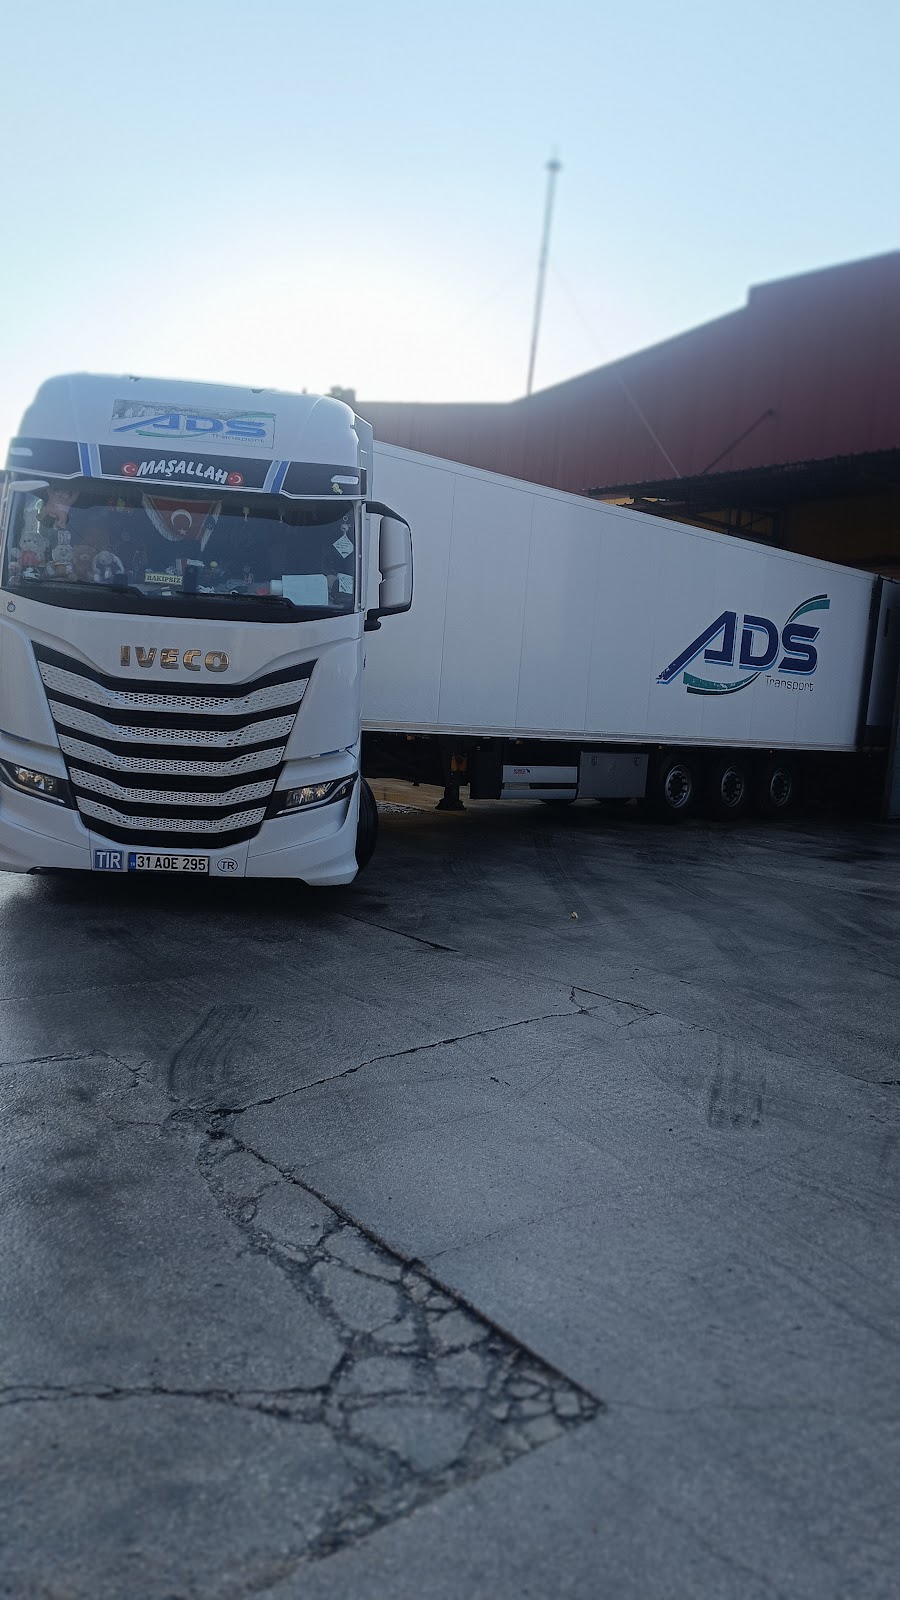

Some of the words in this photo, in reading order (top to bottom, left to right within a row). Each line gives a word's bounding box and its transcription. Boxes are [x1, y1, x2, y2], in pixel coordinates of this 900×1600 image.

[113, 413, 267, 438] ADS
[211, 433, 265, 444] Transport
[136, 459, 229, 485] MAŞALLAH
[656, 610, 820, 685] ADS
[120, 645, 230, 673] IVECO
[765, 675, 814, 692] Transport
[96, 851, 121, 869] TIR
[137, 855, 151, 868] 31
[182, 858, 206, 871] 295
[220, 861, 235, 870] TR
